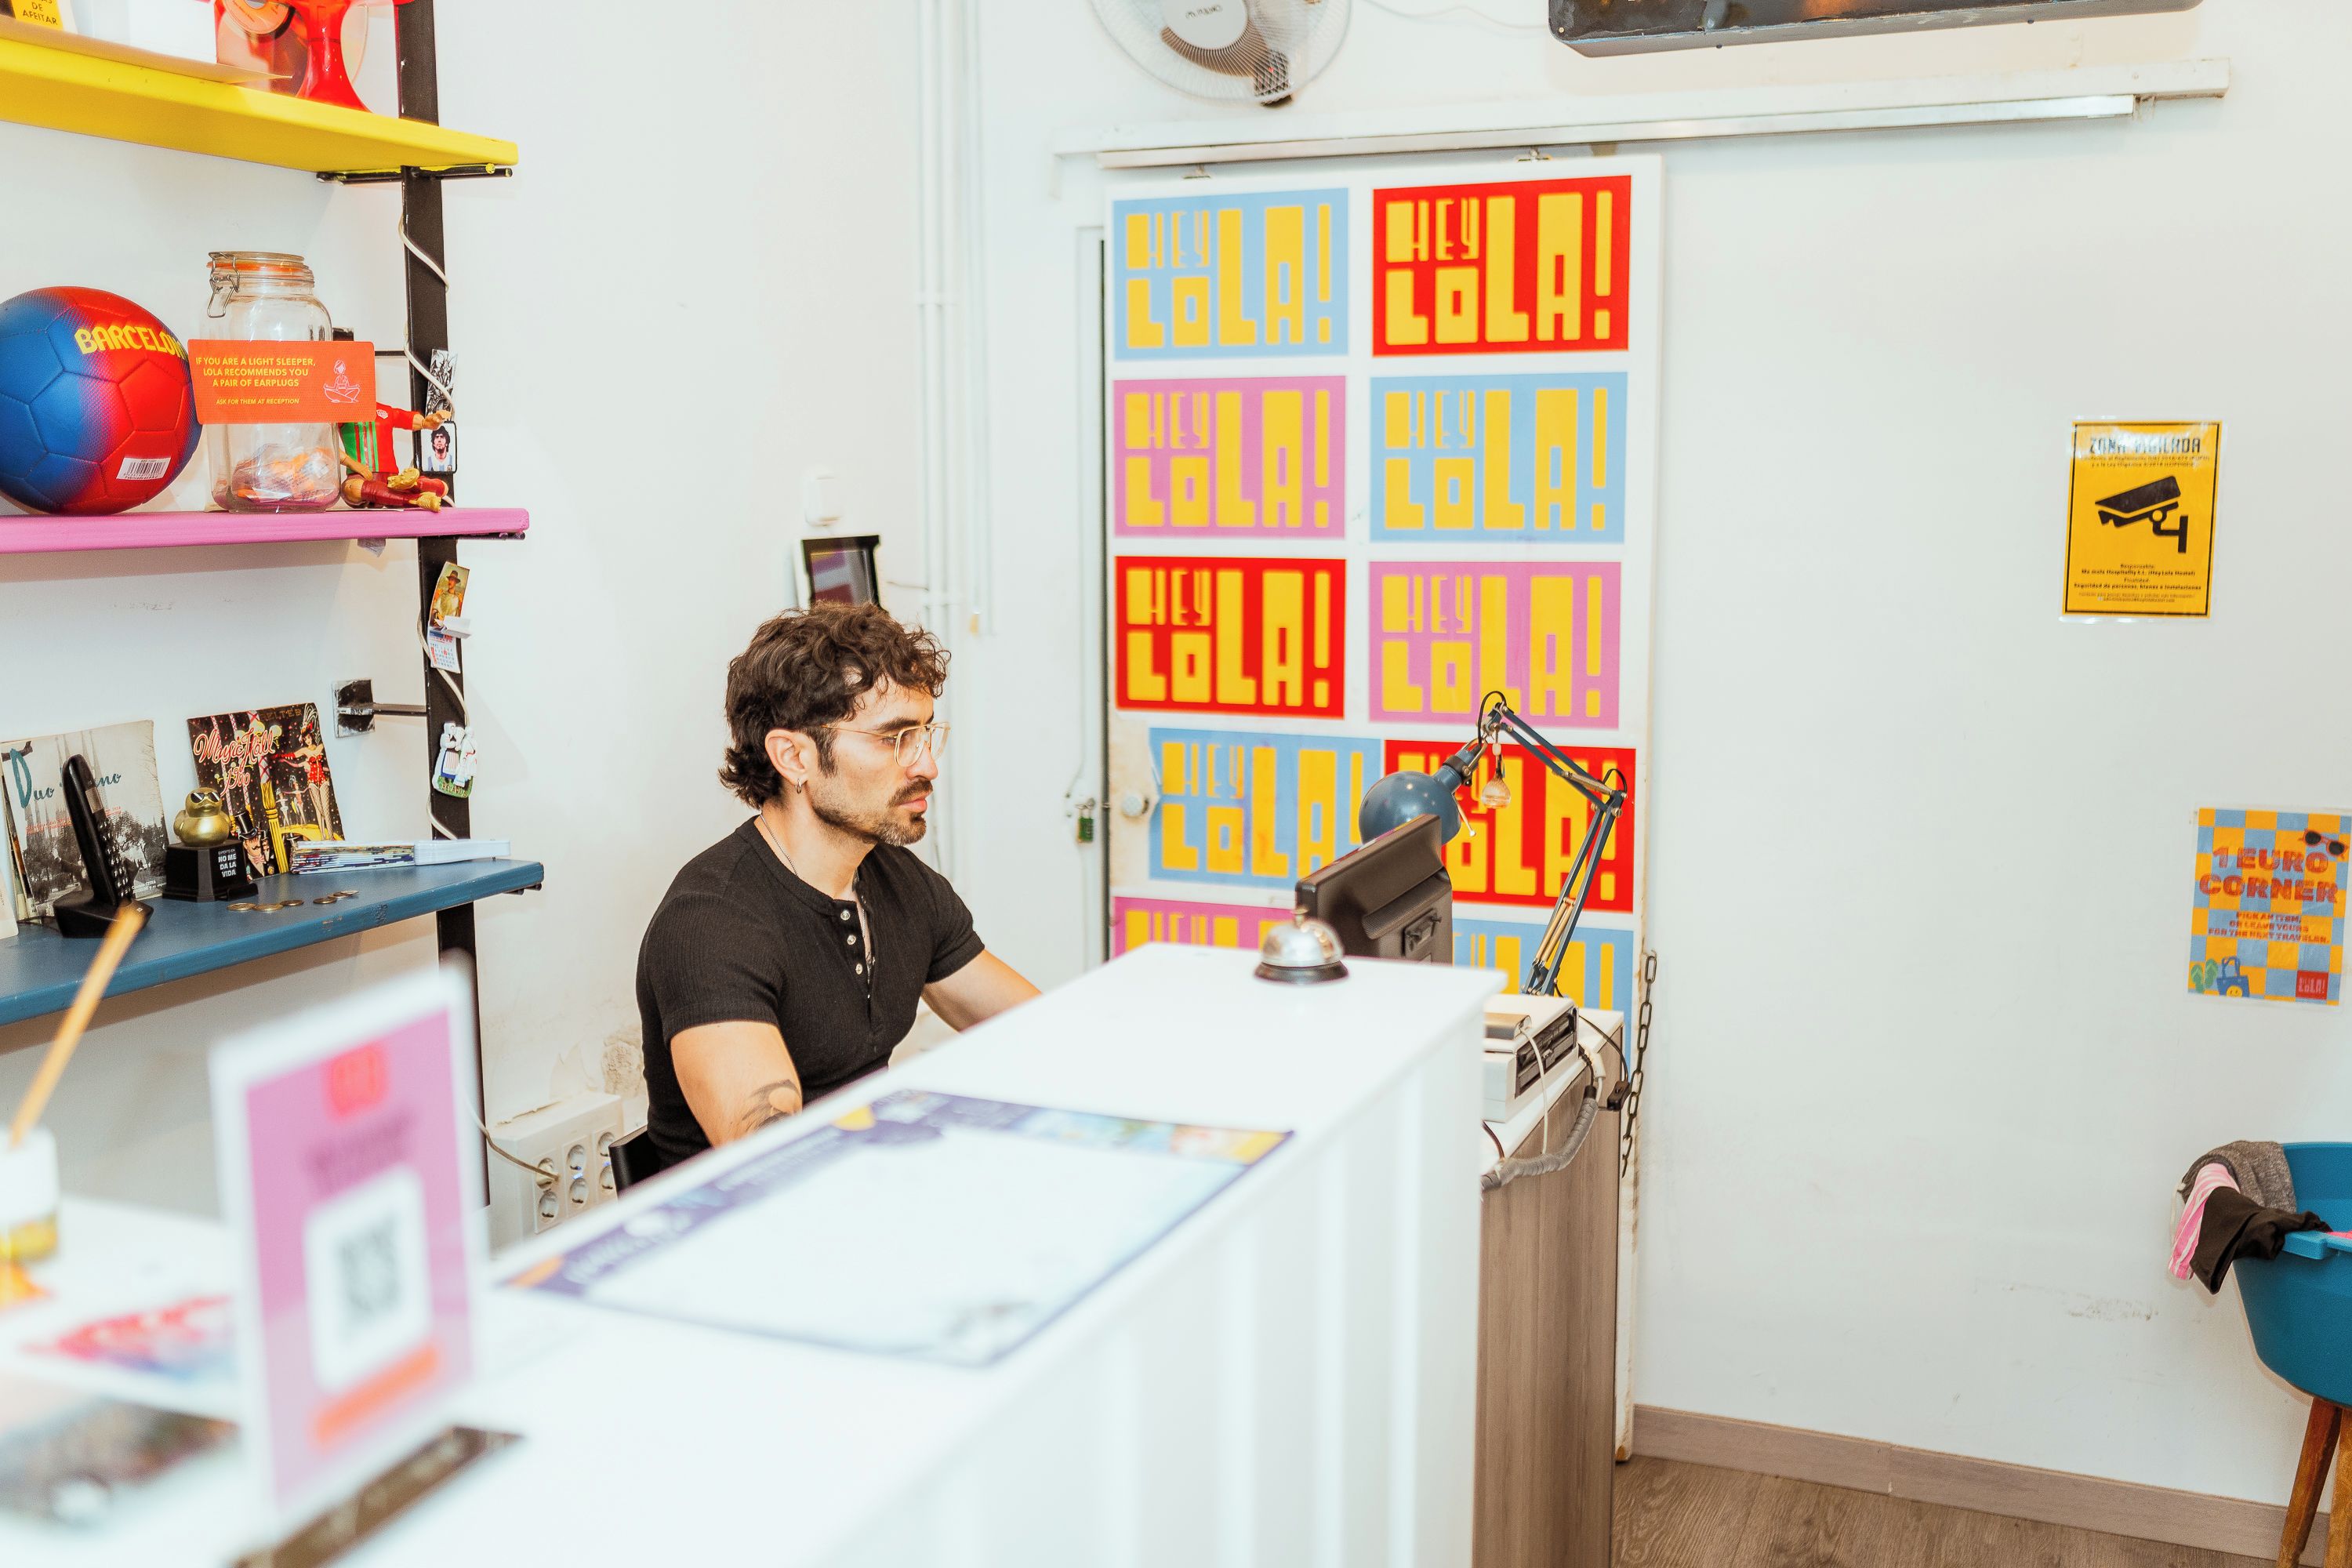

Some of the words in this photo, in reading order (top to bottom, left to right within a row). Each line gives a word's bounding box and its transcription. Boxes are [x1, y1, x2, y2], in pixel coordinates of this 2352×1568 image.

[23, 9, 58, 25] AFEITAR
[31, 2, 43, 11] DE
[1127, 210, 1209, 268] HEY
[1385, 197, 1479, 262] HEY
[1127, 203, 1331, 348] LOLA!
[1385, 190, 1612, 345] LOLA!
[74, 325, 188, 362] BARCELON
[203, 357, 220, 365] YOU
[1125, 390, 1209, 449] HEY
[1385, 390, 1475, 448] HEY
[2090, 437, 2125, 453] ZONA
[2136, 437, 2201, 454] VIGILADA
[1125, 388, 1330, 528] LOLA!
[1385, 387, 1607, 531] LOLA!
[1127, 568, 1210, 626] HEY
[1382, 575, 1472, 633] HEY
[1127, 568, 1330, 707] LOLA!
[1382, 575, 1602, 717] LOLA!
[10, 748, 55, 808] Duo
[1162, 742, 1244, 799] HEY
[2199, 873, 2338, 903] CORNER
[2212, 846, 2230, 869] 1
[2236, 847, 2329, 875] EURO
[2208, 927, 2227, 936] FOR
[2229, 929, 2248, 938] THE
[2249, 930, 2274, 940] NEXT
[2229, 920, 2242, 928] OR
[2244, 921, 2274, 931] LEAVE
[2236, 911, 2259, 920] PICK
